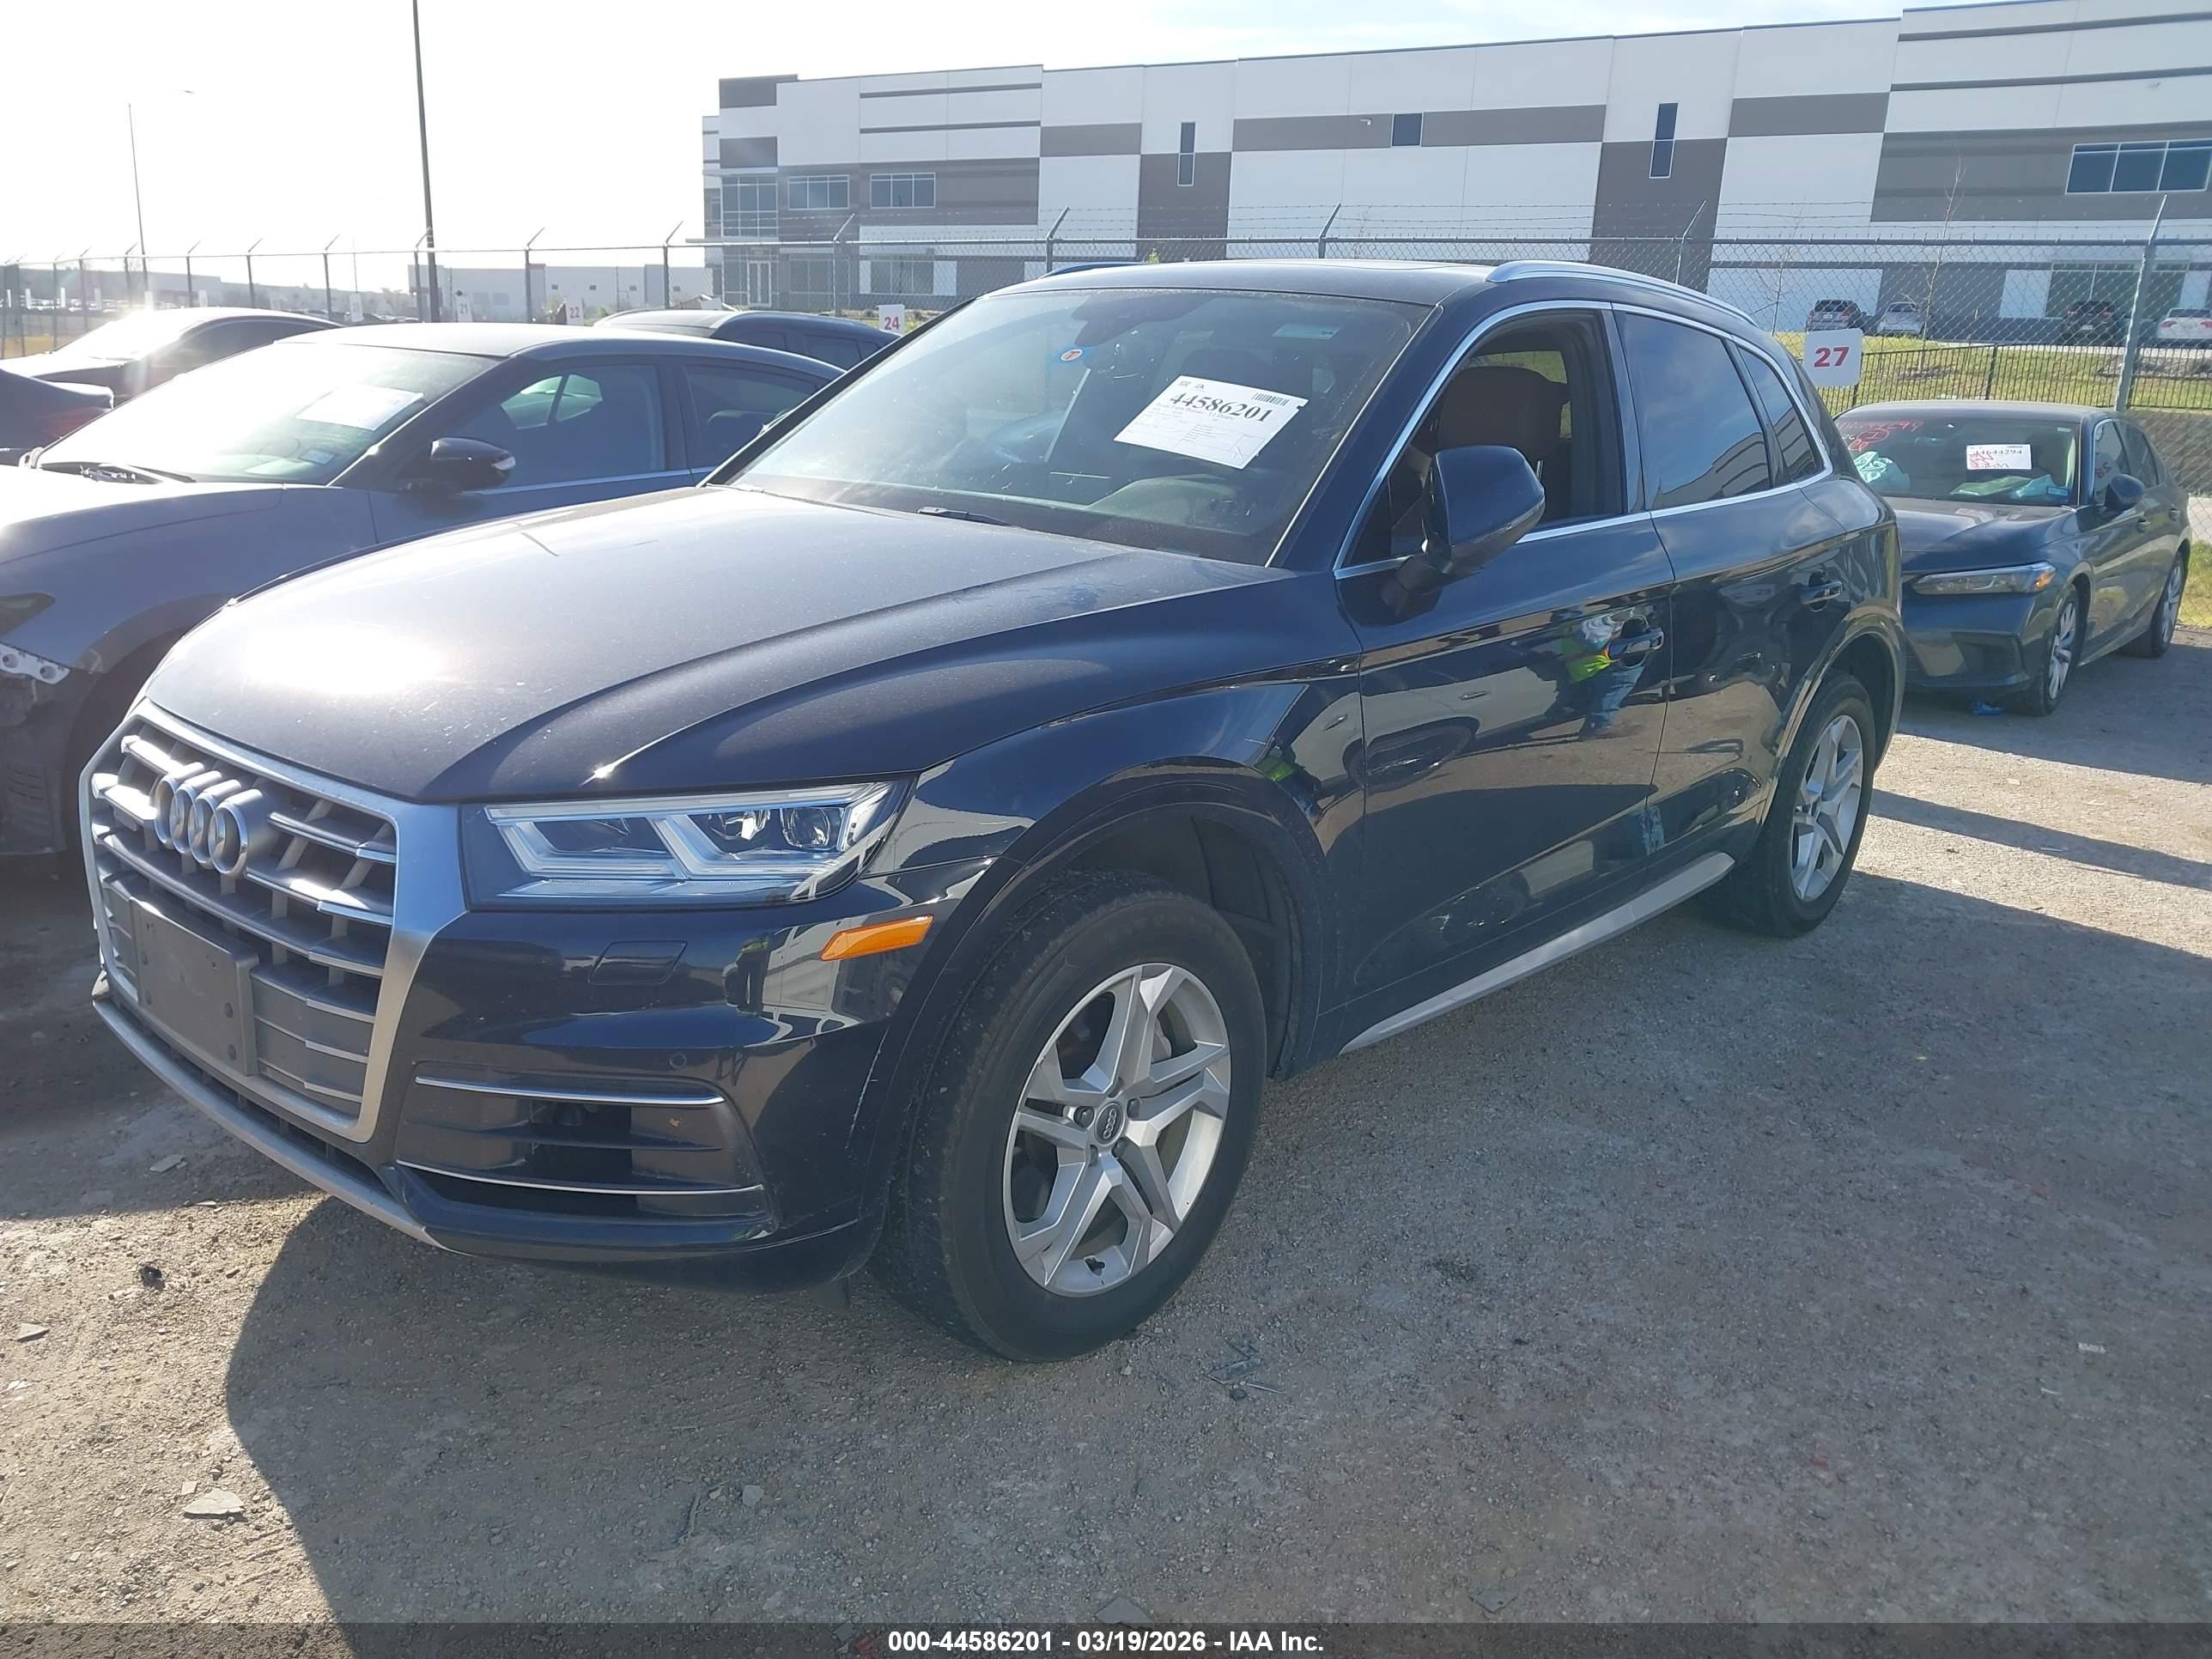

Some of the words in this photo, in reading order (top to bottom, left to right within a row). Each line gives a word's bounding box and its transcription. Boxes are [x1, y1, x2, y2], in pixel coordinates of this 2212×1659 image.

[569, 307, 580, 319] 22
[884, 316, 900, 331] 24
[1814, 346, 1850, 368] 27
[1170, 392, 1273, 422] 44586201
